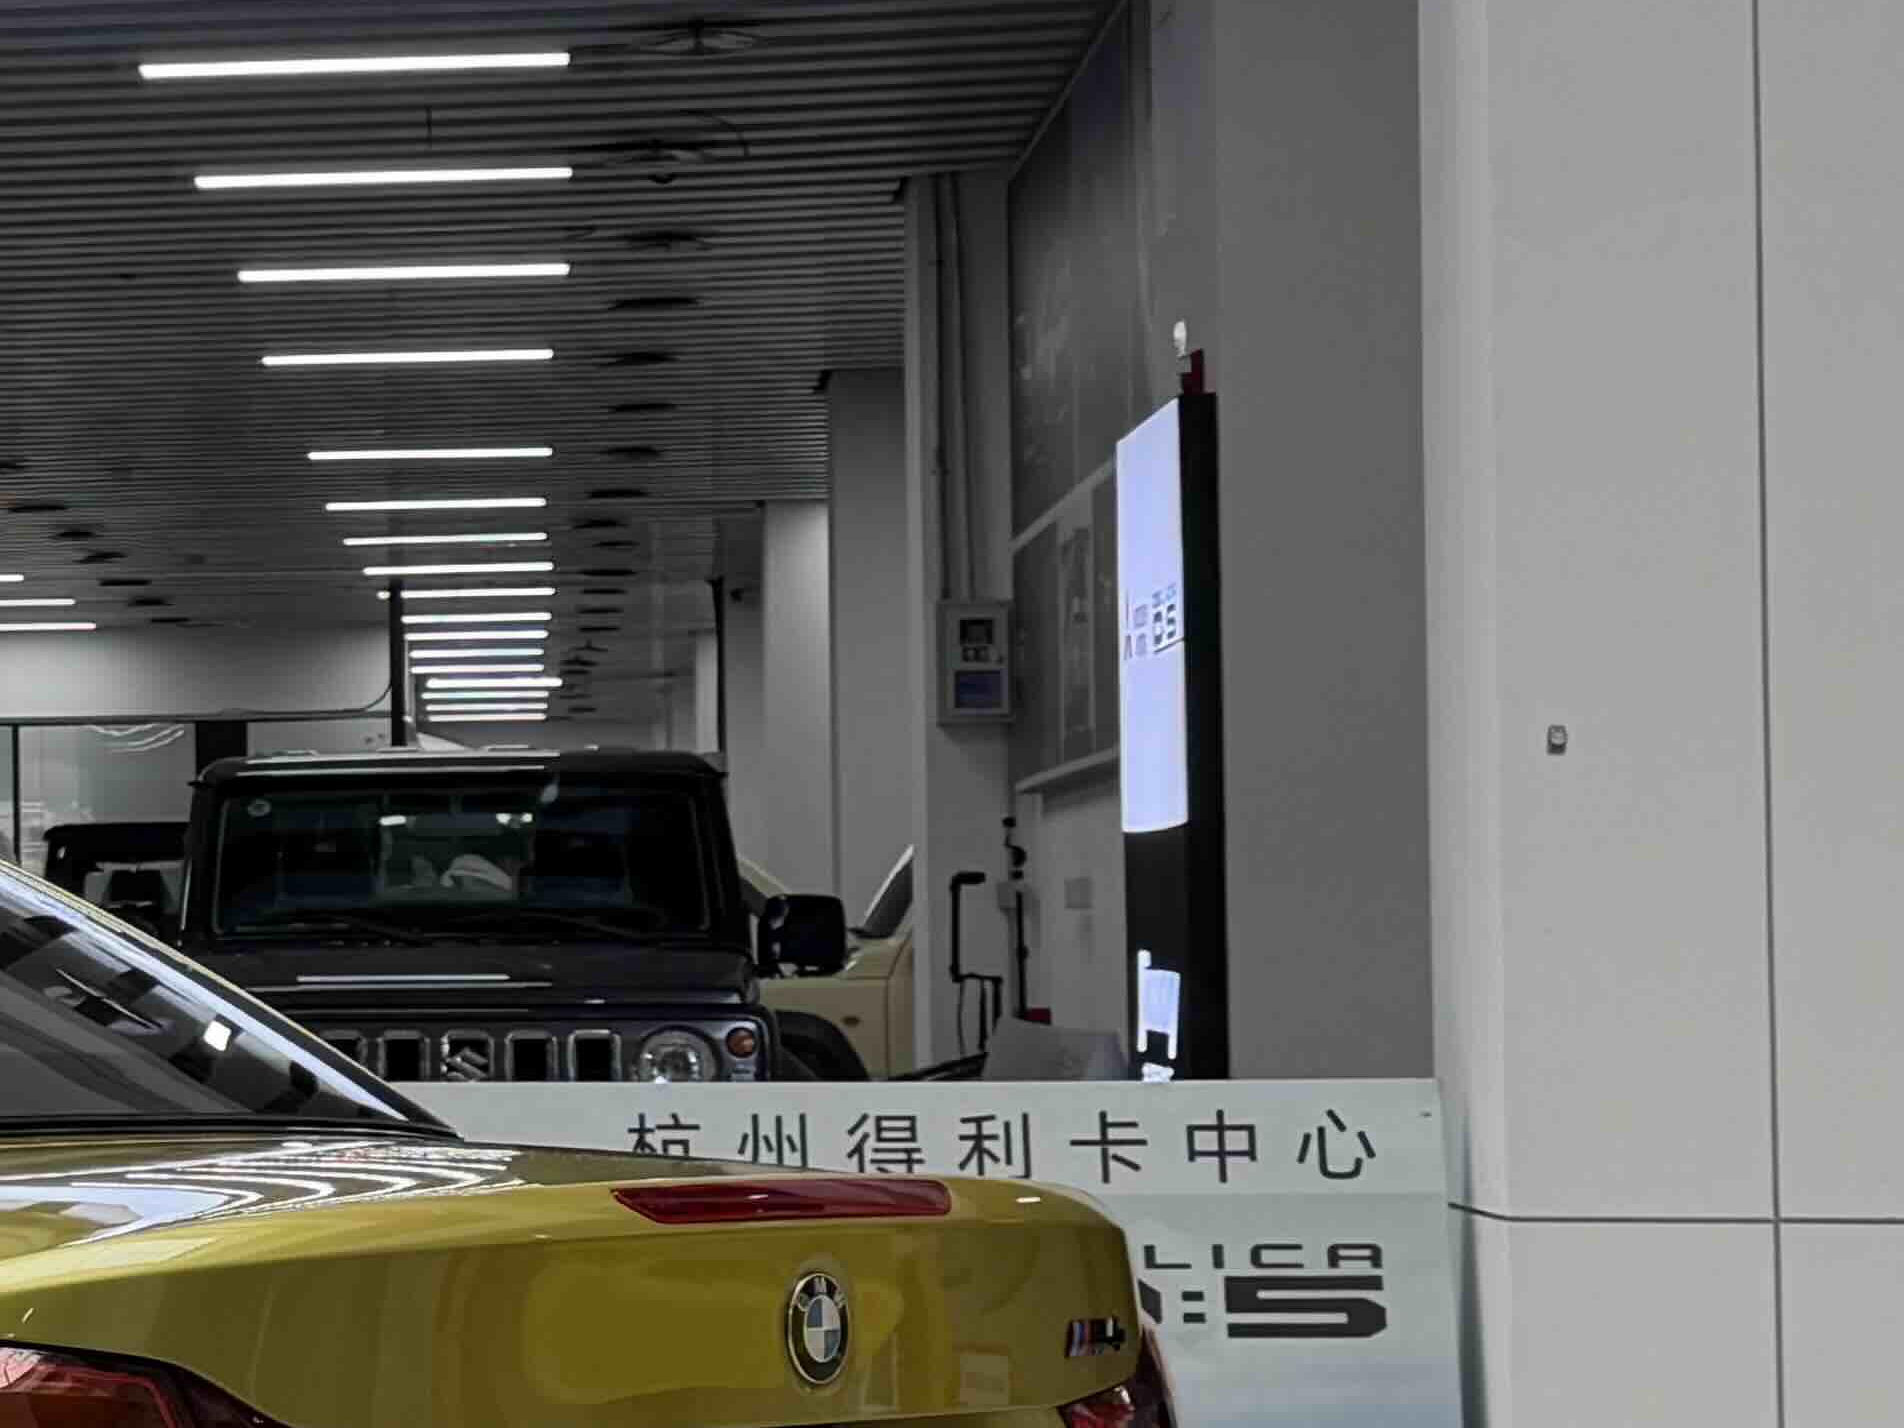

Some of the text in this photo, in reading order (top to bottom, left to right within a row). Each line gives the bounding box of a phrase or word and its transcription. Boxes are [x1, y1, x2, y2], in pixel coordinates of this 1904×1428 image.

[627, 1109, 1377, 1183] 杭州得利卡中心
[1144, 1243, 1383, 1269] LICA
